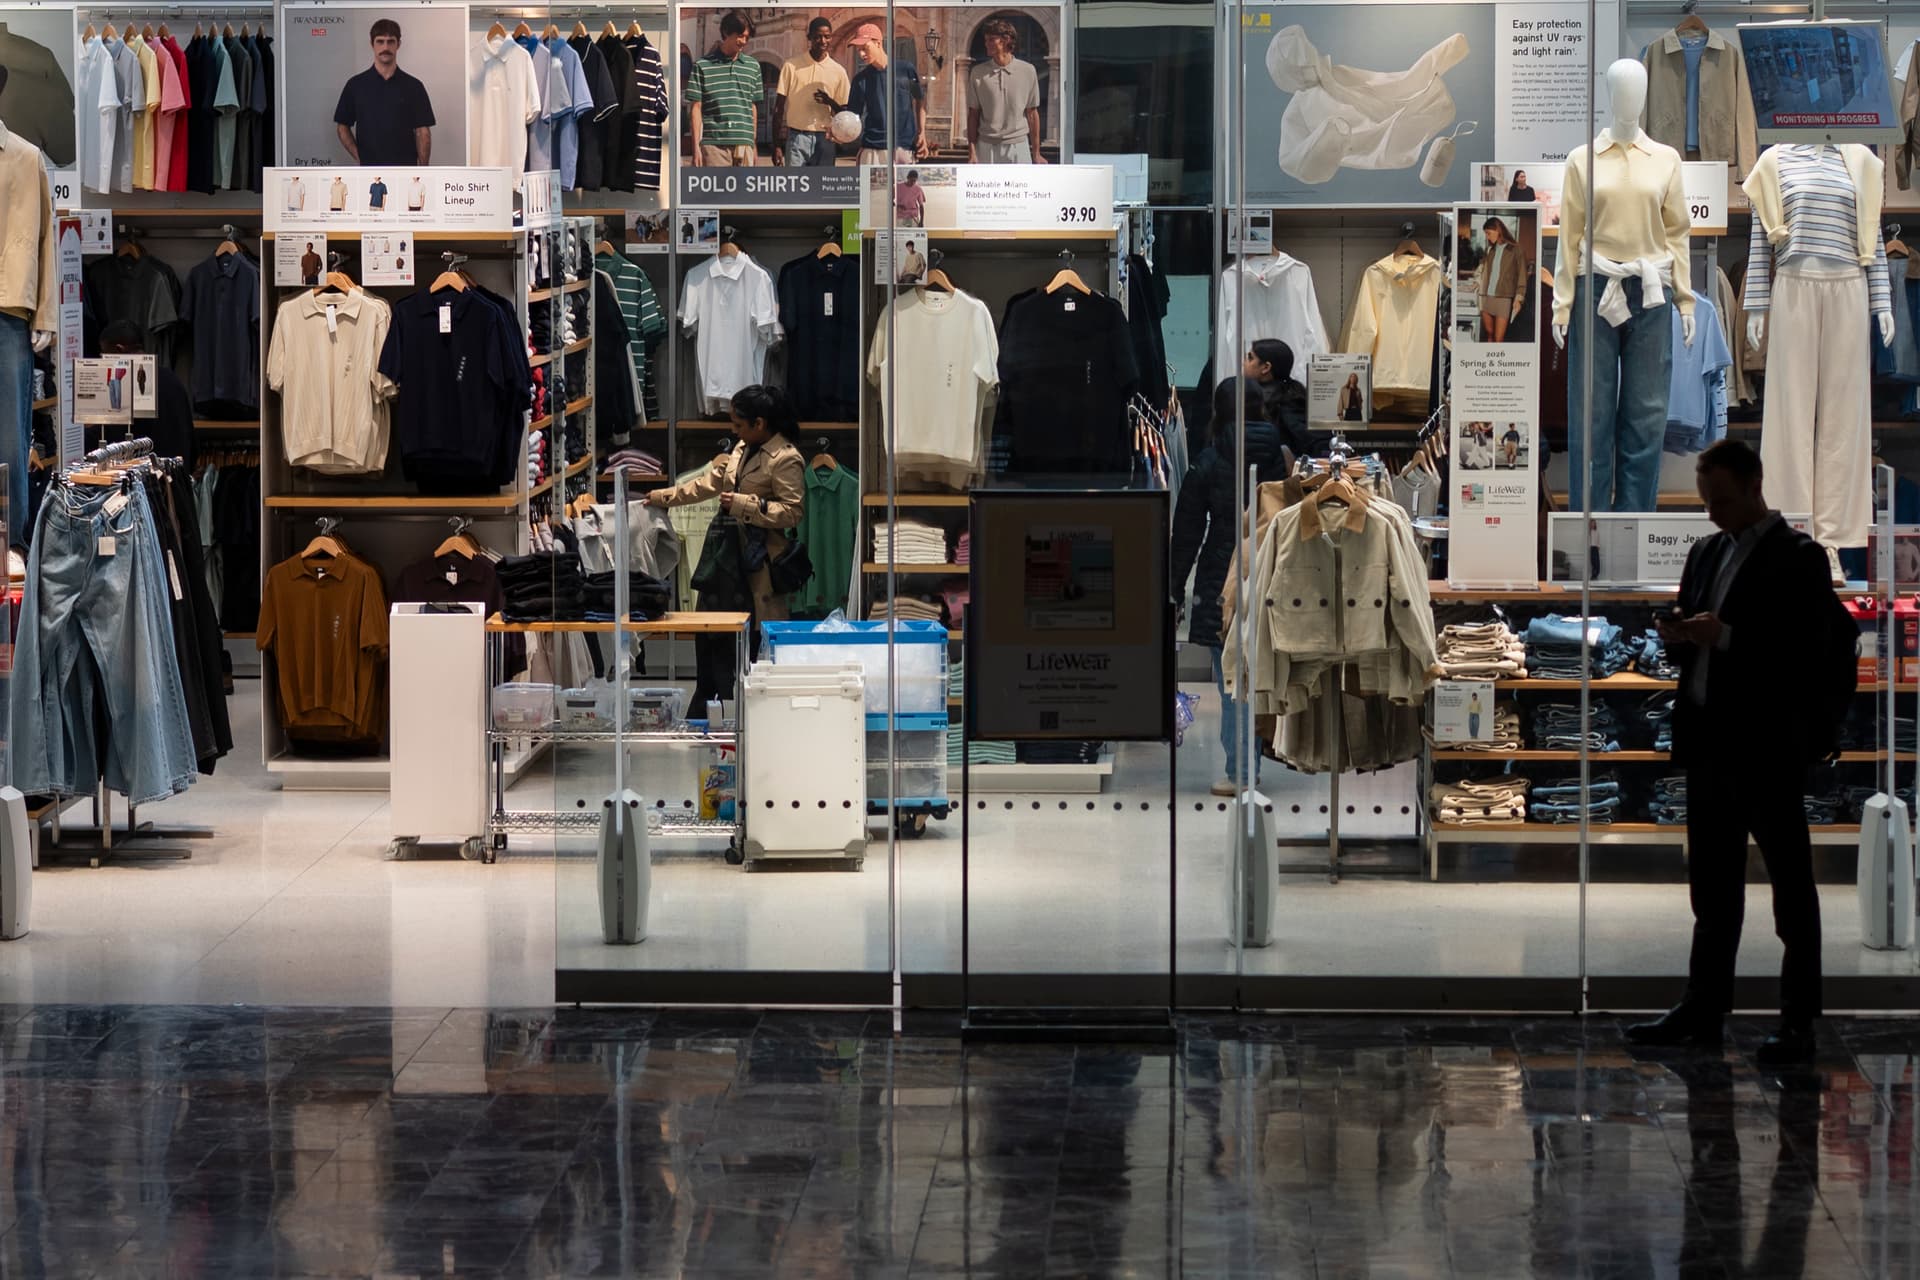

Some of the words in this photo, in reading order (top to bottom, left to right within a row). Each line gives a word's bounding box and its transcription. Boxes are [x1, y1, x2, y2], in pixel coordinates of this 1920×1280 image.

[1512, 19, 1533, 30] Easy
[1537, 19, 1582, 30] protection
[1512, 33, 1543, 44] against
[1547, 33, 1559, 42] UV
[1512, 47, 1528, 55] and
[1532, 47, 1551, 57] light
[1775, 115, 1826, 124] MONITORING
[1827, 115, 1836, 123] IN
[1837, 115, 1877, 123] PROGRESS
[445, 183, 465, 192] Polo
[468, 183, 490, 192] Shirt
[688, 176, 737, 193] POLO
[746, 176, 810, 193] SHIRTS
[445, 196, 475, 206] Lineup
[1691, 205, 1709, 219] 90
[1486, 350, 1506, 358] 2026
[1460, 360, 1487, 369] Spring
[1497, 360, 1531, 368] Summer
[1474, 369, 1516, 377] Collection
[1488, 485, 1526, 495] LifeWear
[1648, 533, 1679, 546] Baggy
[1026, 653, 1111, 671] LifeWear
